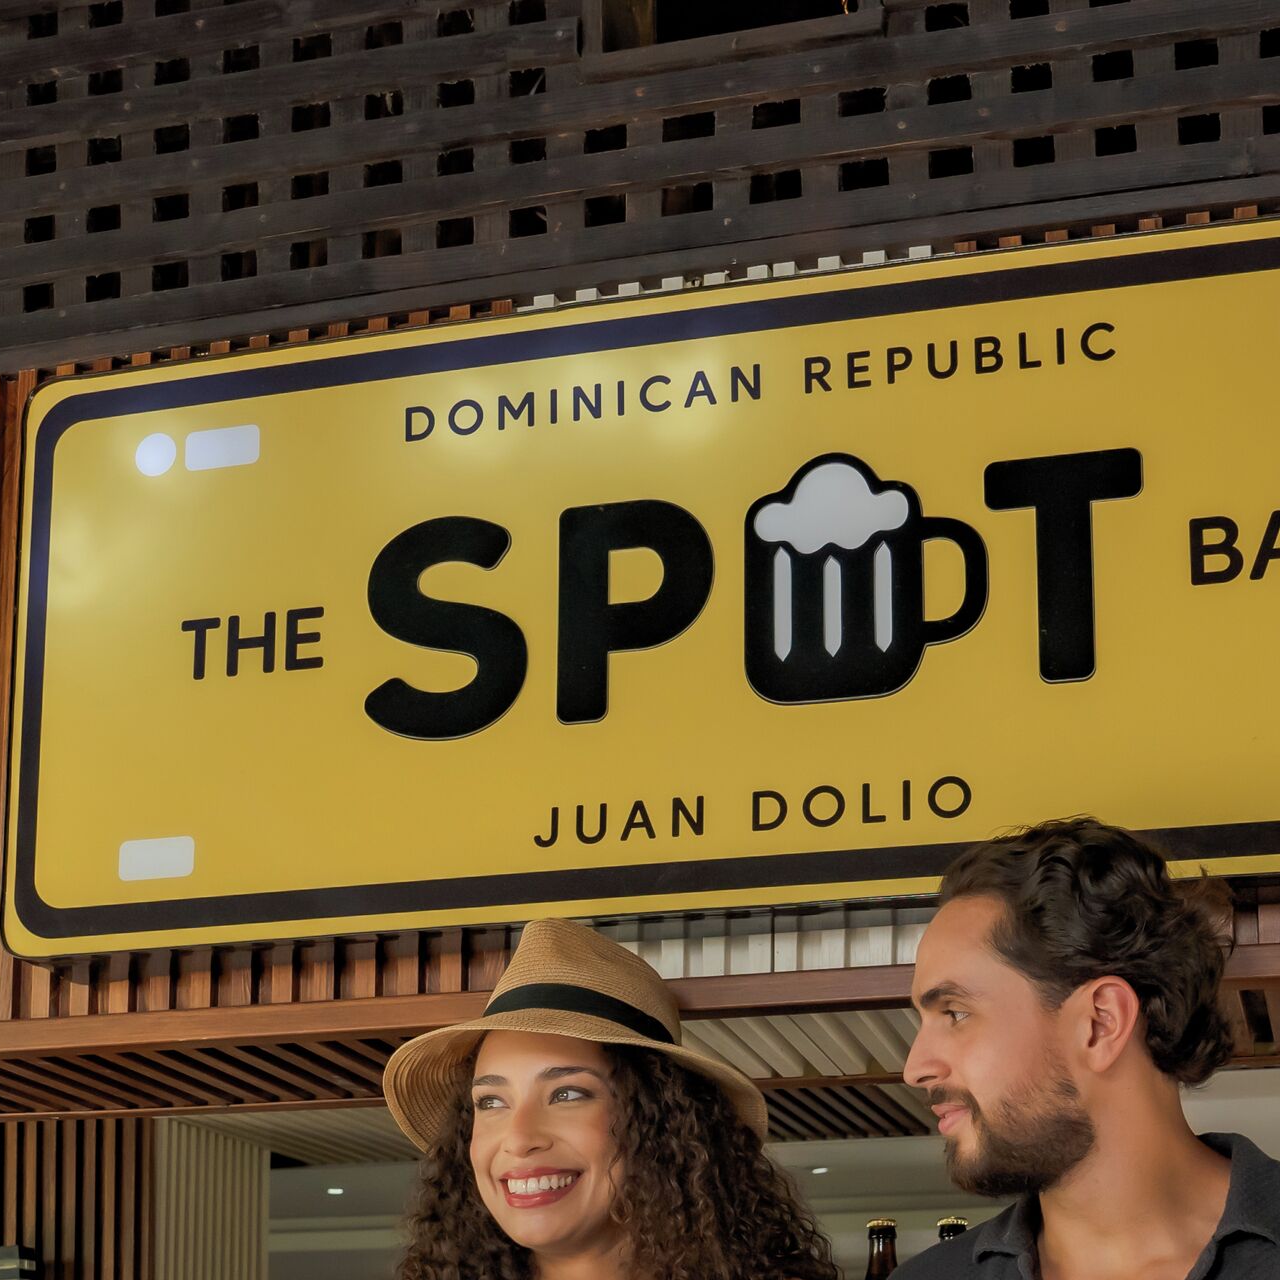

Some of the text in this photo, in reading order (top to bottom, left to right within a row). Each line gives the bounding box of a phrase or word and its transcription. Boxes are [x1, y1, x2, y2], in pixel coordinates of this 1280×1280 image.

[405, 322, 1116, 443] DOMINICAN REPUBLIC
[181, 606, 325, 681] THE
[533, 775, 972, 850] JUAN DOLIO
